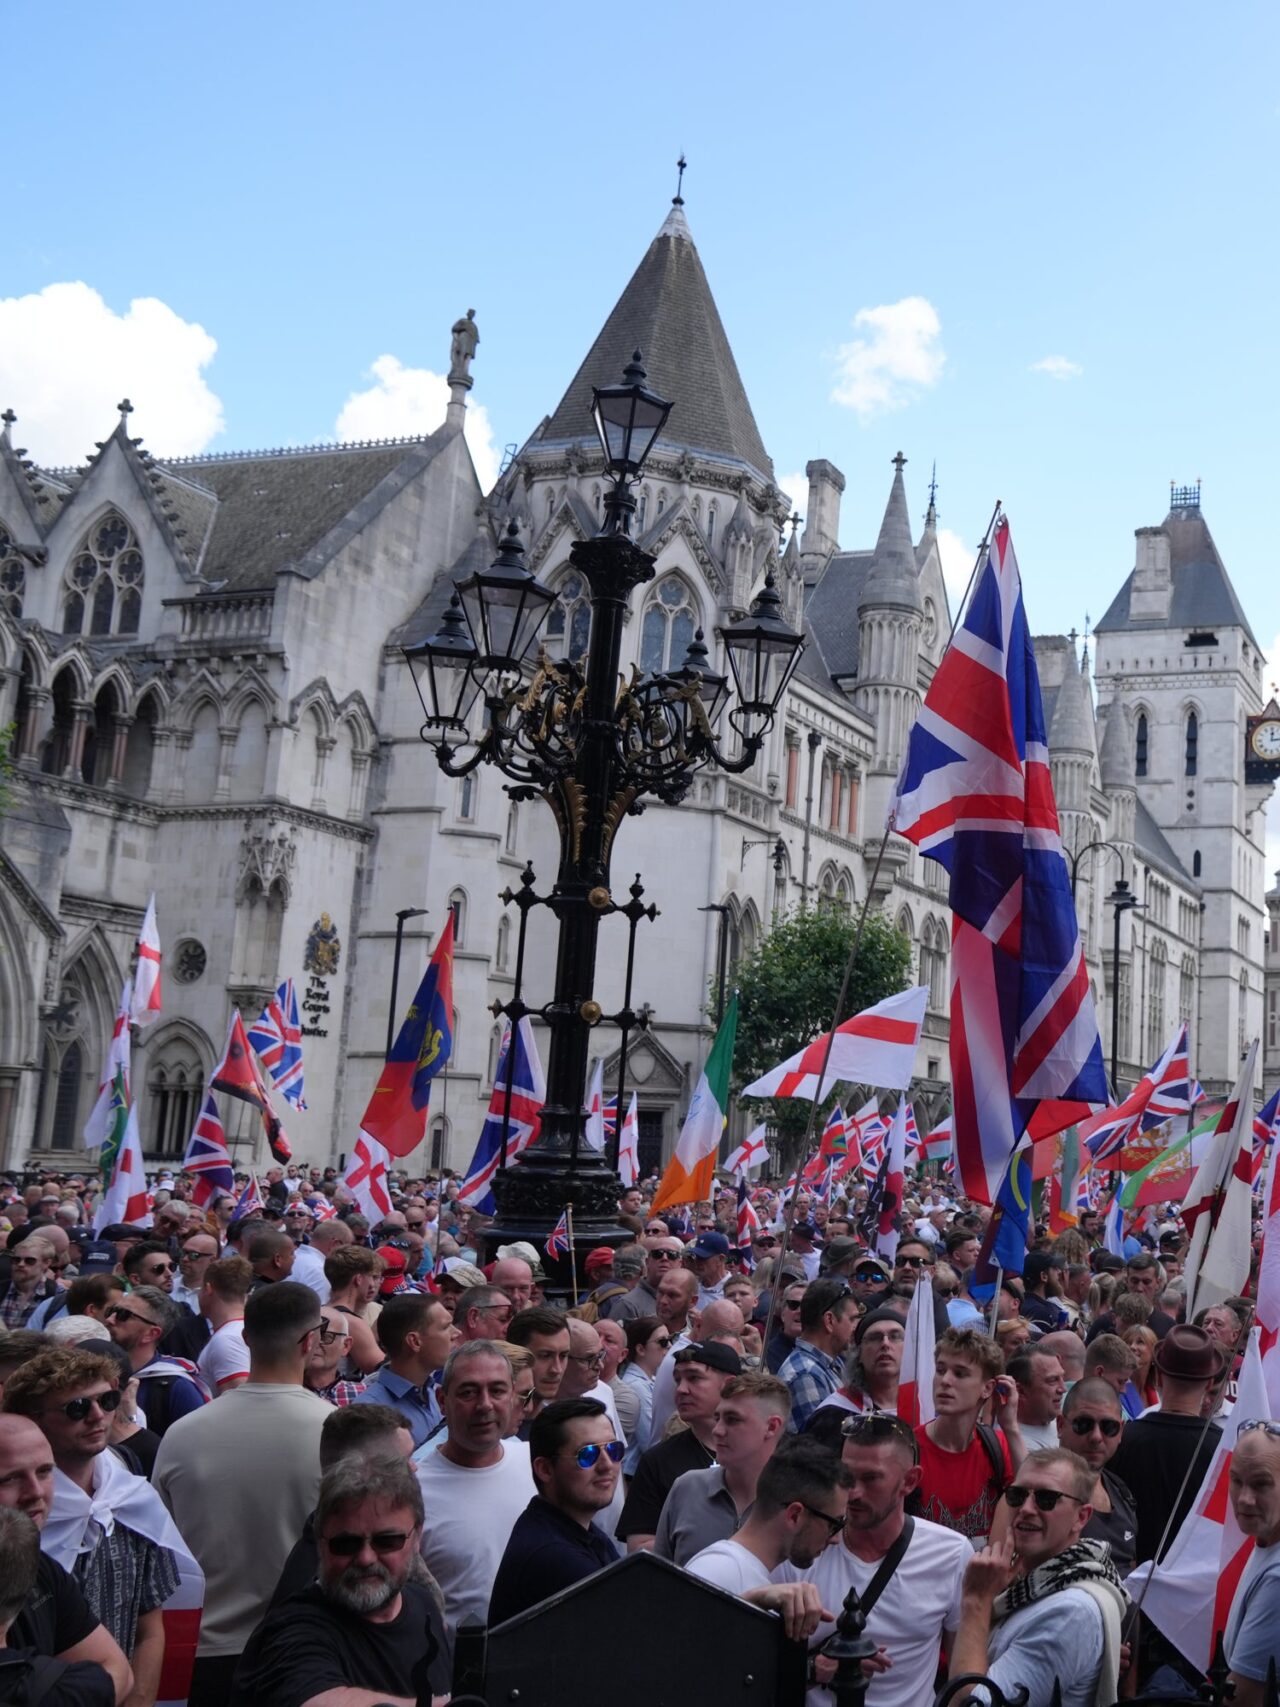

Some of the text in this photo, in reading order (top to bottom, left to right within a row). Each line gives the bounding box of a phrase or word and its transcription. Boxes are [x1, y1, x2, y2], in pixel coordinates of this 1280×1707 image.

[310, 976, 327, 990] The
[305, 988, 330, 1003] Royal
[302, 1000, 331, 1014] Courts
[309, 1014, 321, 1025] of
